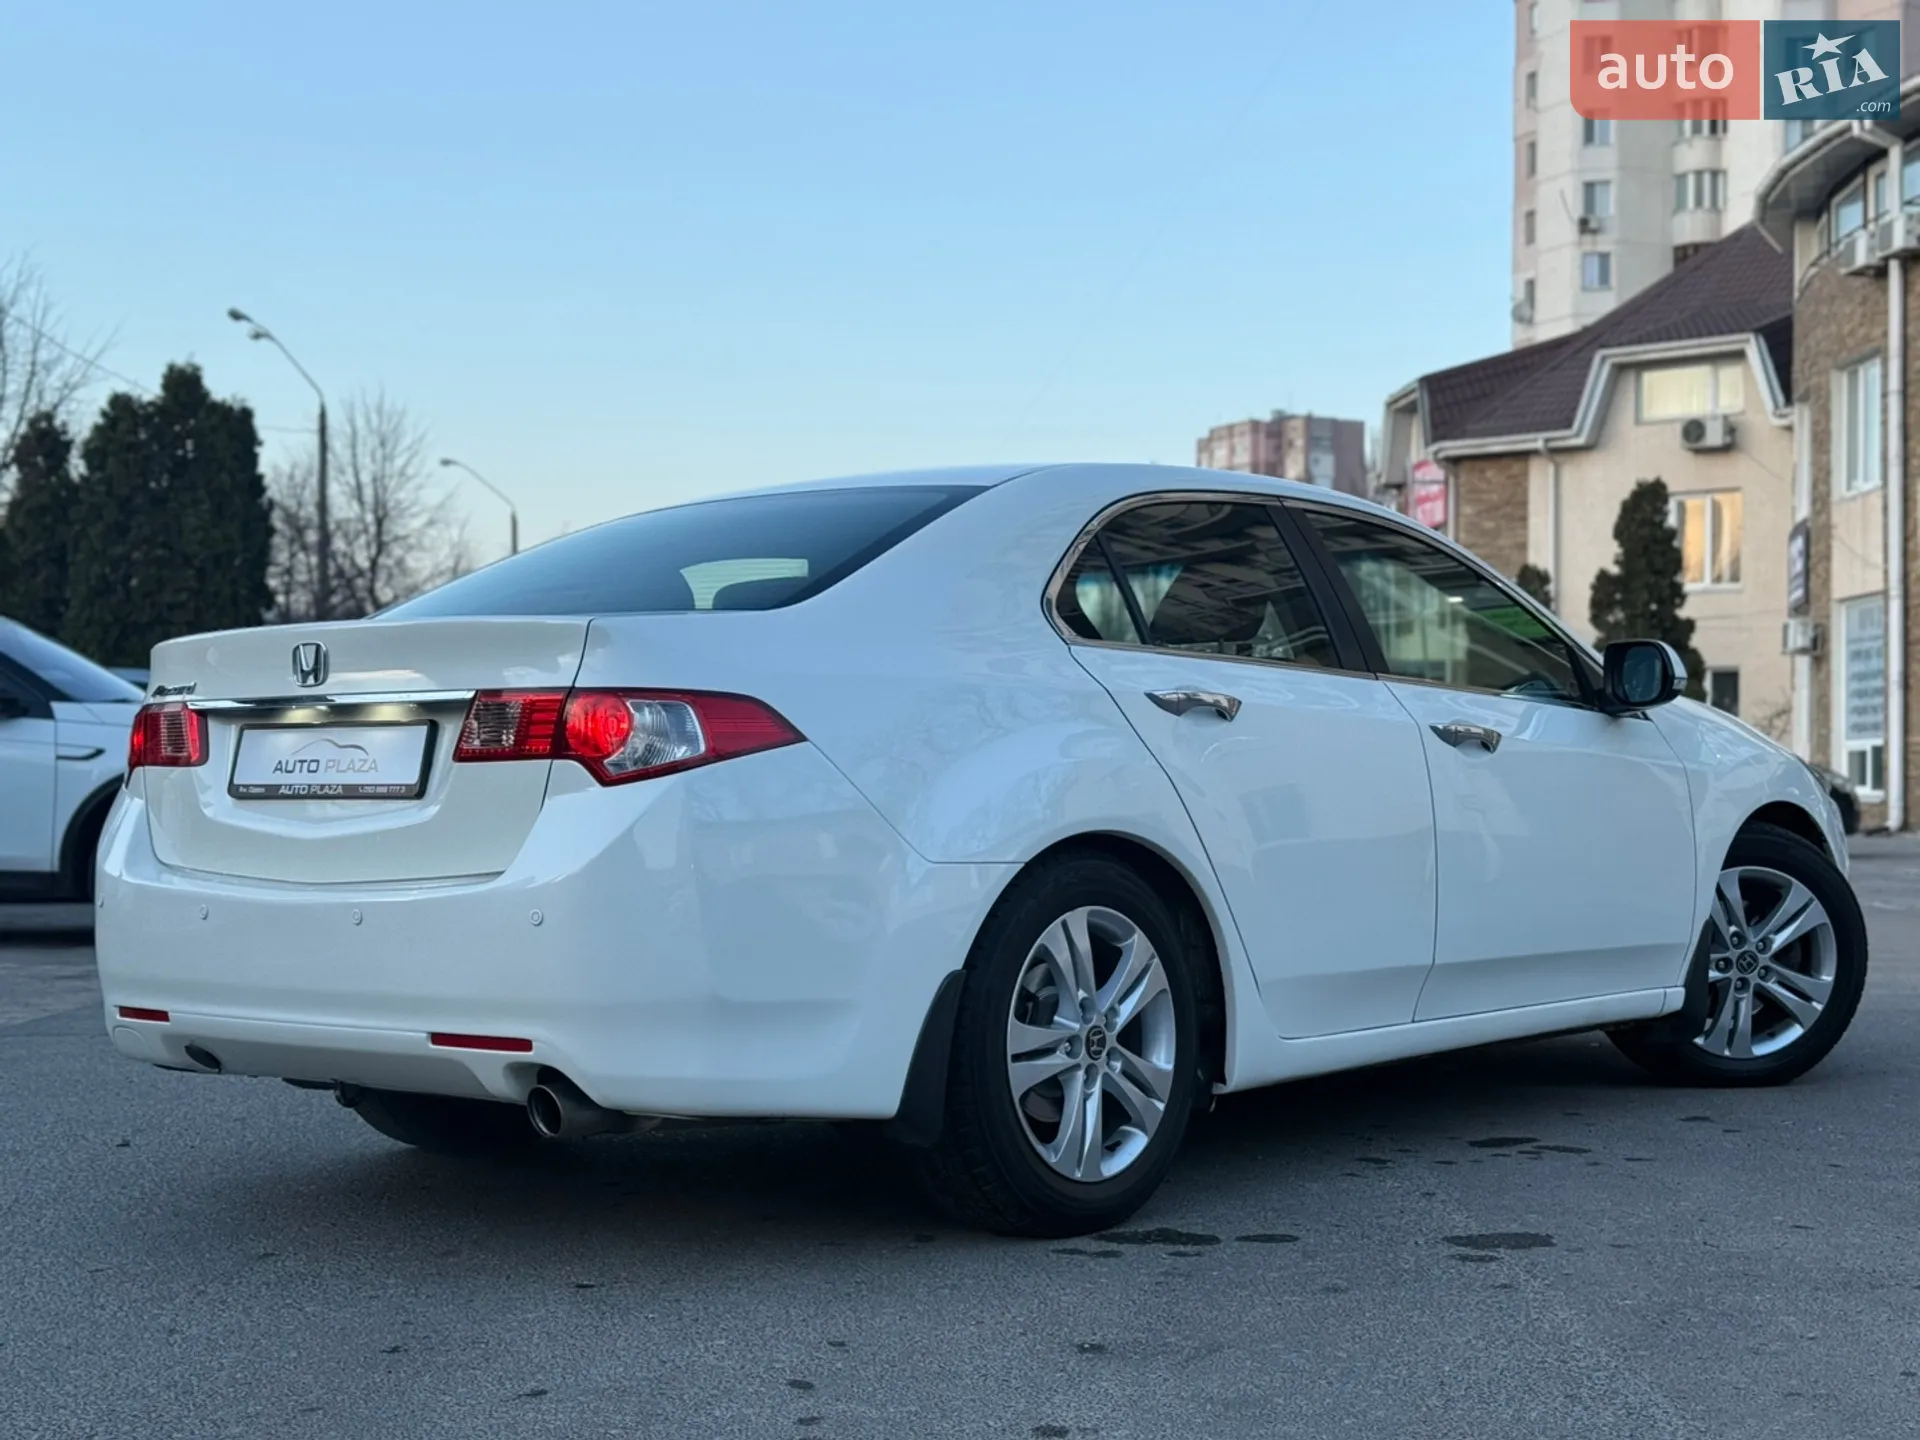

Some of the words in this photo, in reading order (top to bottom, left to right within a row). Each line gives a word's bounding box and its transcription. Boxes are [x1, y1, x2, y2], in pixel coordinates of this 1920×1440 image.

[273, 759, 320, 774] AUTO
[324, 758, 378, 773] PLAZA
[279, 785, 309, 795] AUTO
[310, 784, 343, 795] PLAZA
